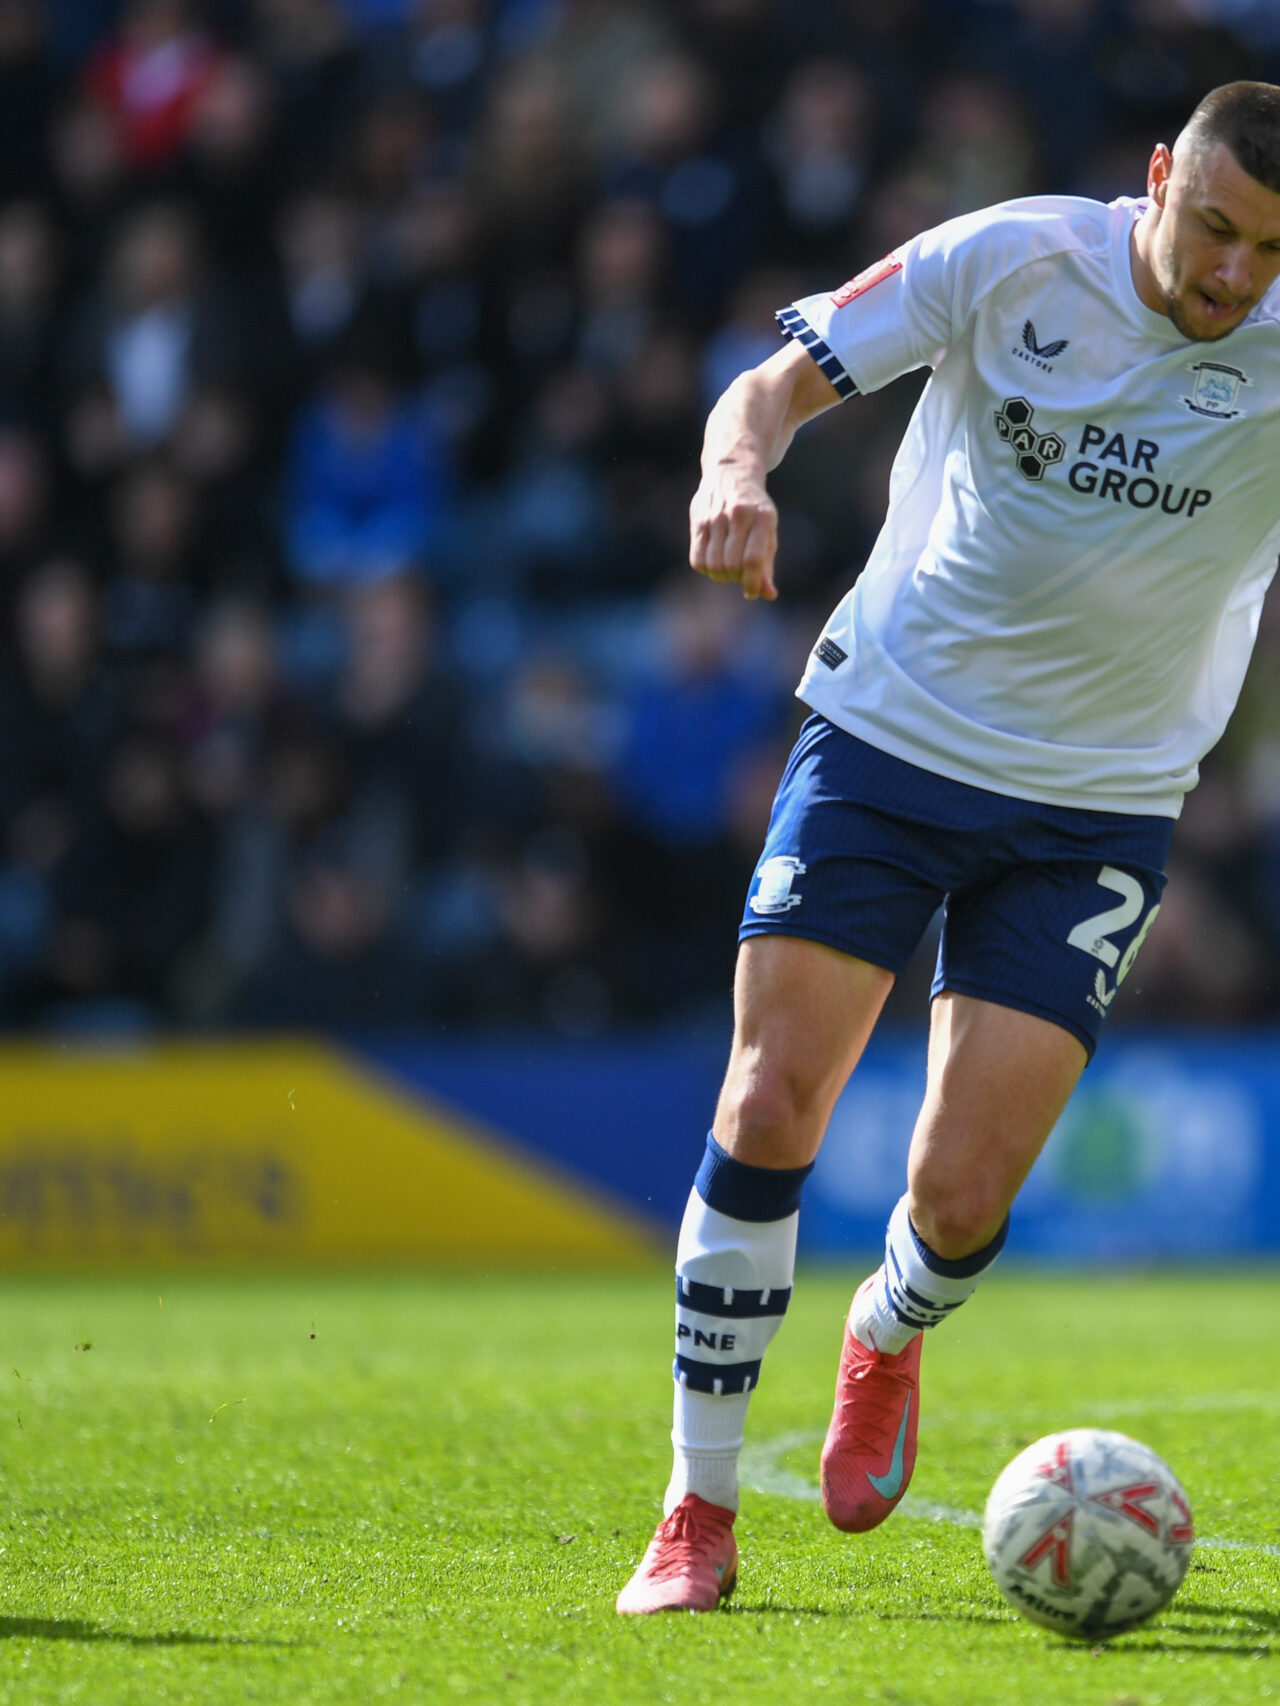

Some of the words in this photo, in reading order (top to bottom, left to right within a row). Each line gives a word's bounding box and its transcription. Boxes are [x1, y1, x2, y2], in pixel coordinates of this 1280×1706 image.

[1011, 347, 1053, 374] CASTORE
[1078, 423, 1160, 474] PAR
[1068, 461, 1212, 518] GROUP
[677, 1322, 736, 1351] PNE
